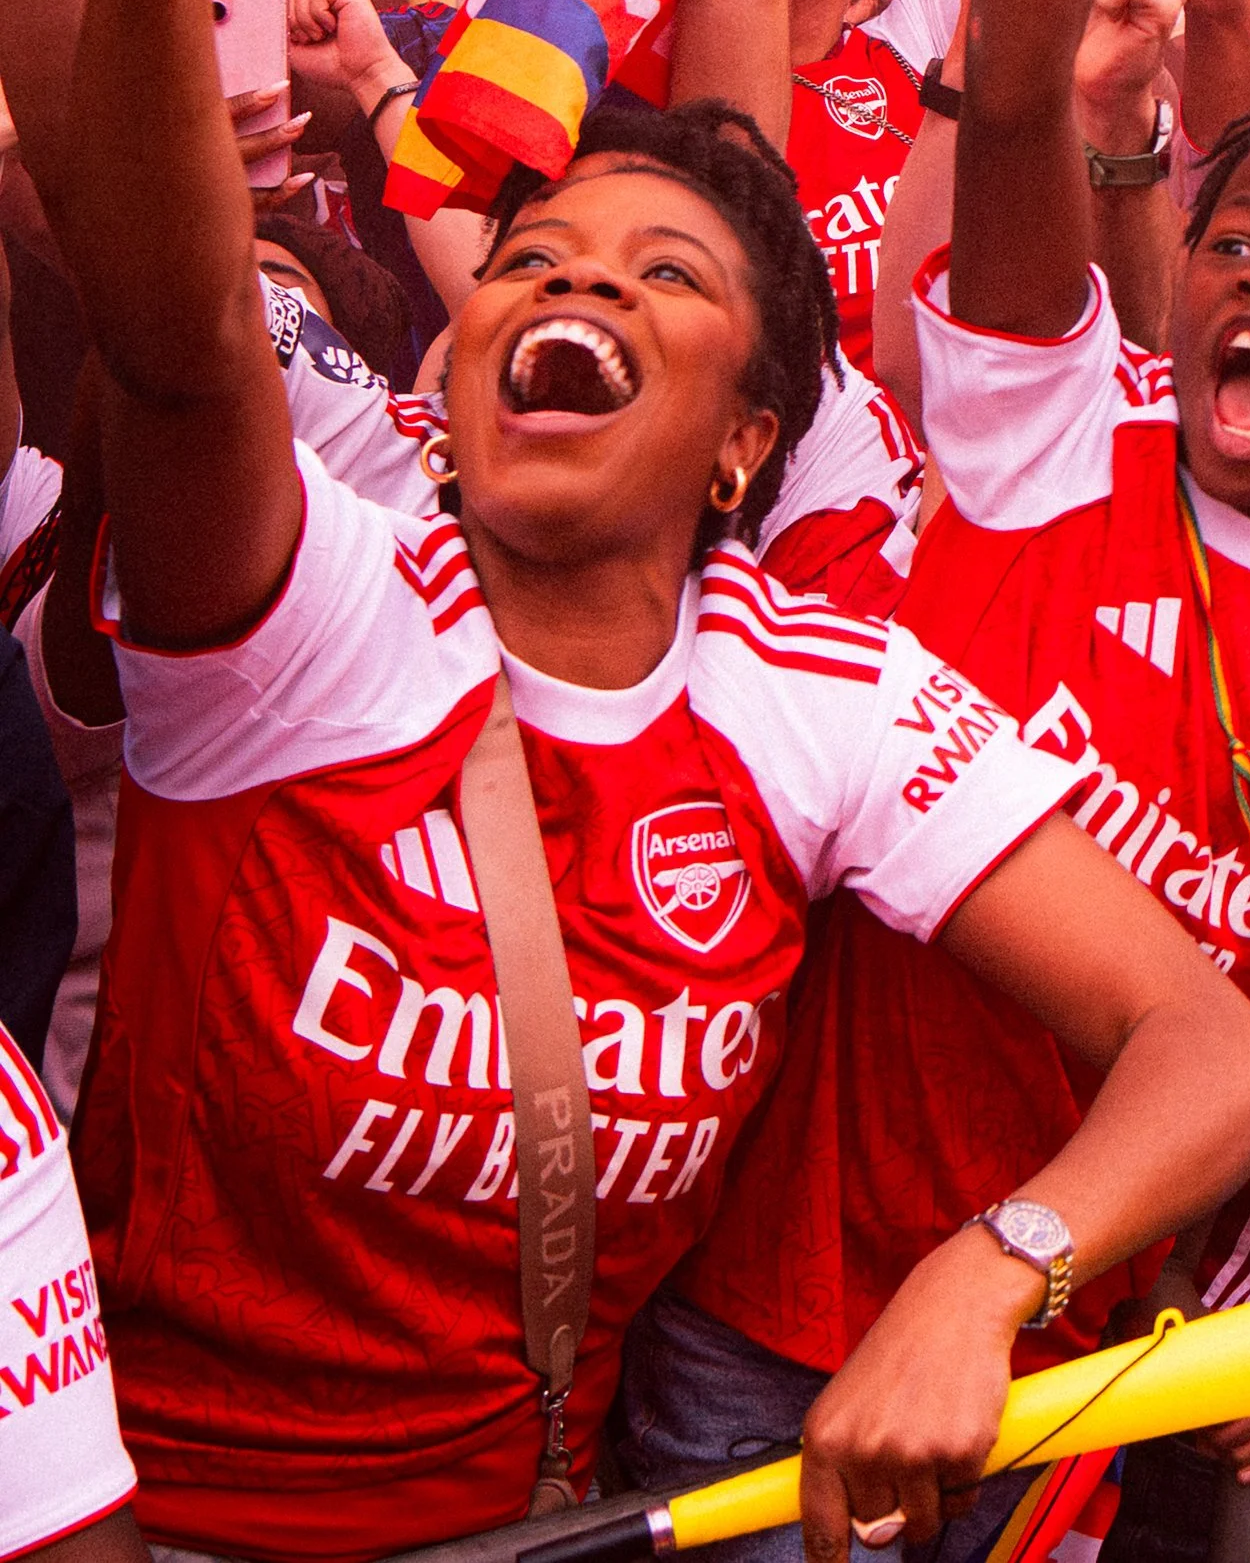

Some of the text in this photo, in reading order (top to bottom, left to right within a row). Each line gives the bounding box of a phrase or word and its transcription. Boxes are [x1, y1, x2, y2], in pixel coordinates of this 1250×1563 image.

[902, 703, 1009, 814] RWAN
[648, 824, 735, 859] Arsenal
[323, 1099, 473, 1197] FLY
[534, 1085, 577, 1309] PRADA
